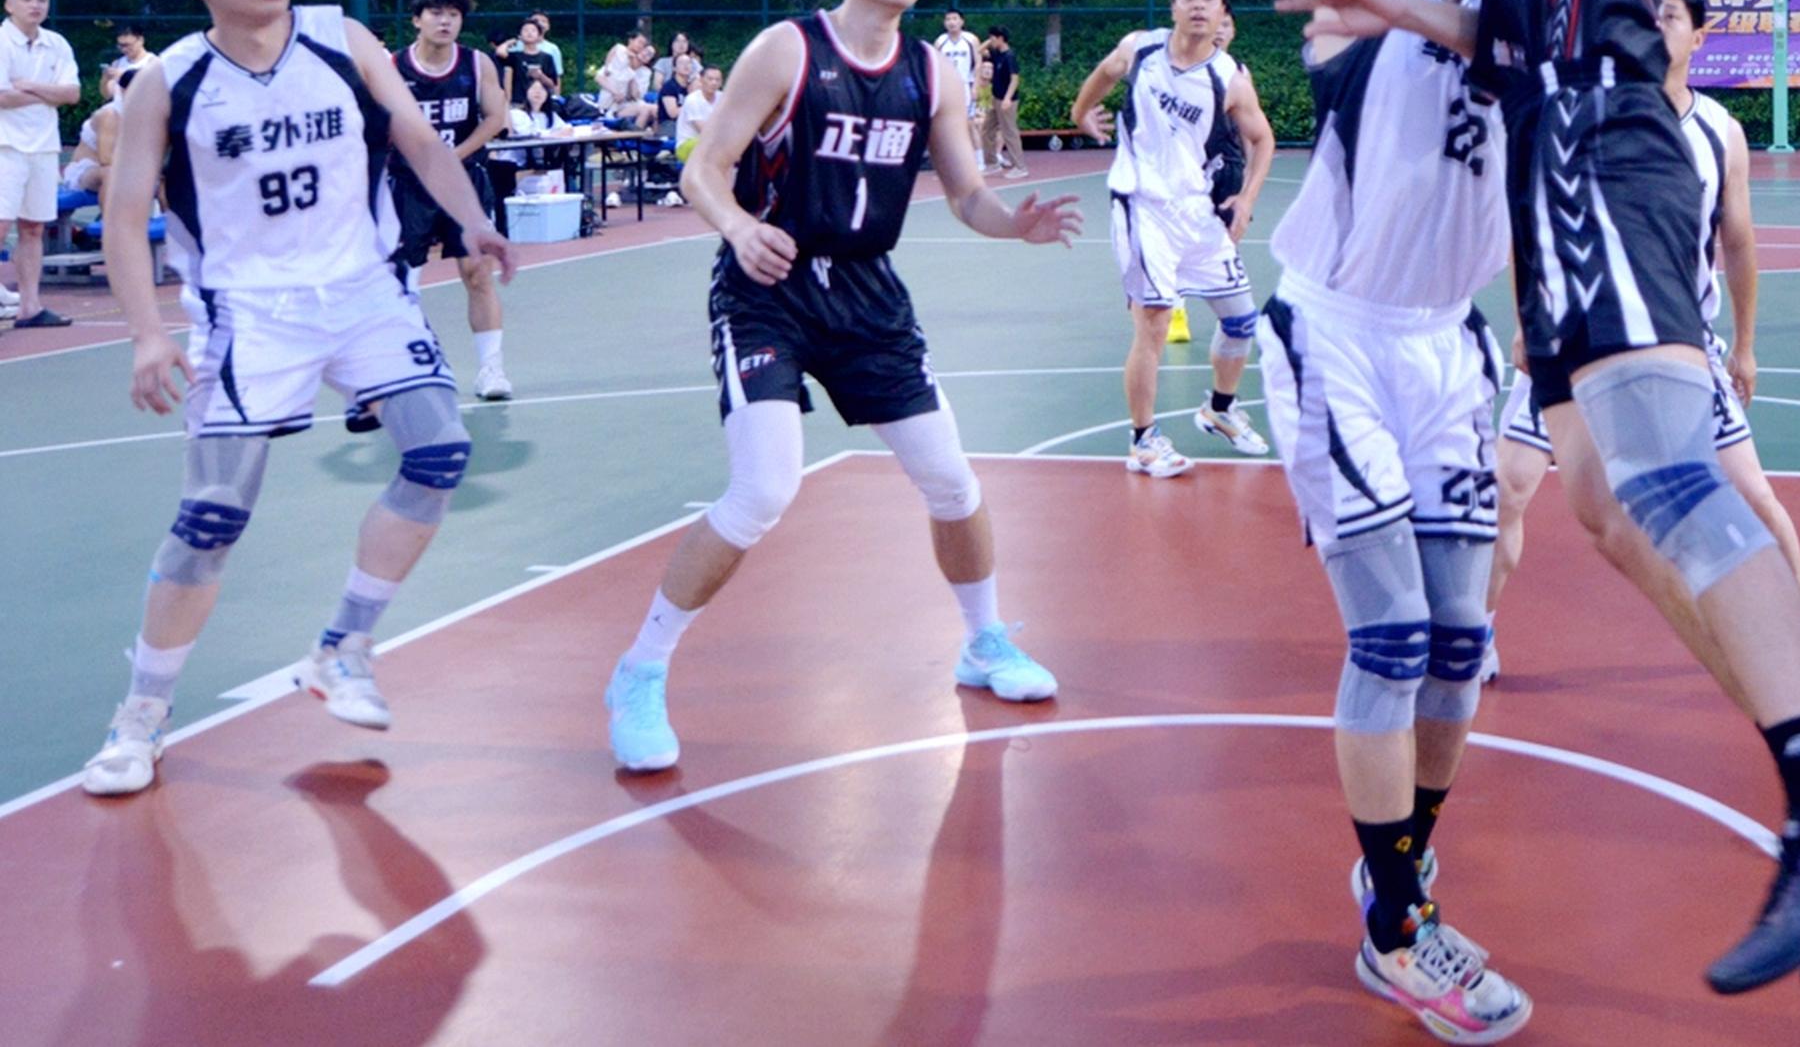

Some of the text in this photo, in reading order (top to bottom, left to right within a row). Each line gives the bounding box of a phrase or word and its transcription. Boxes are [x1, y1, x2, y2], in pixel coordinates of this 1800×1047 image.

[815, 112, 916, 166] 正通
[258, 164, 320, 217] 93
[850, 177, 868, 231] 1
